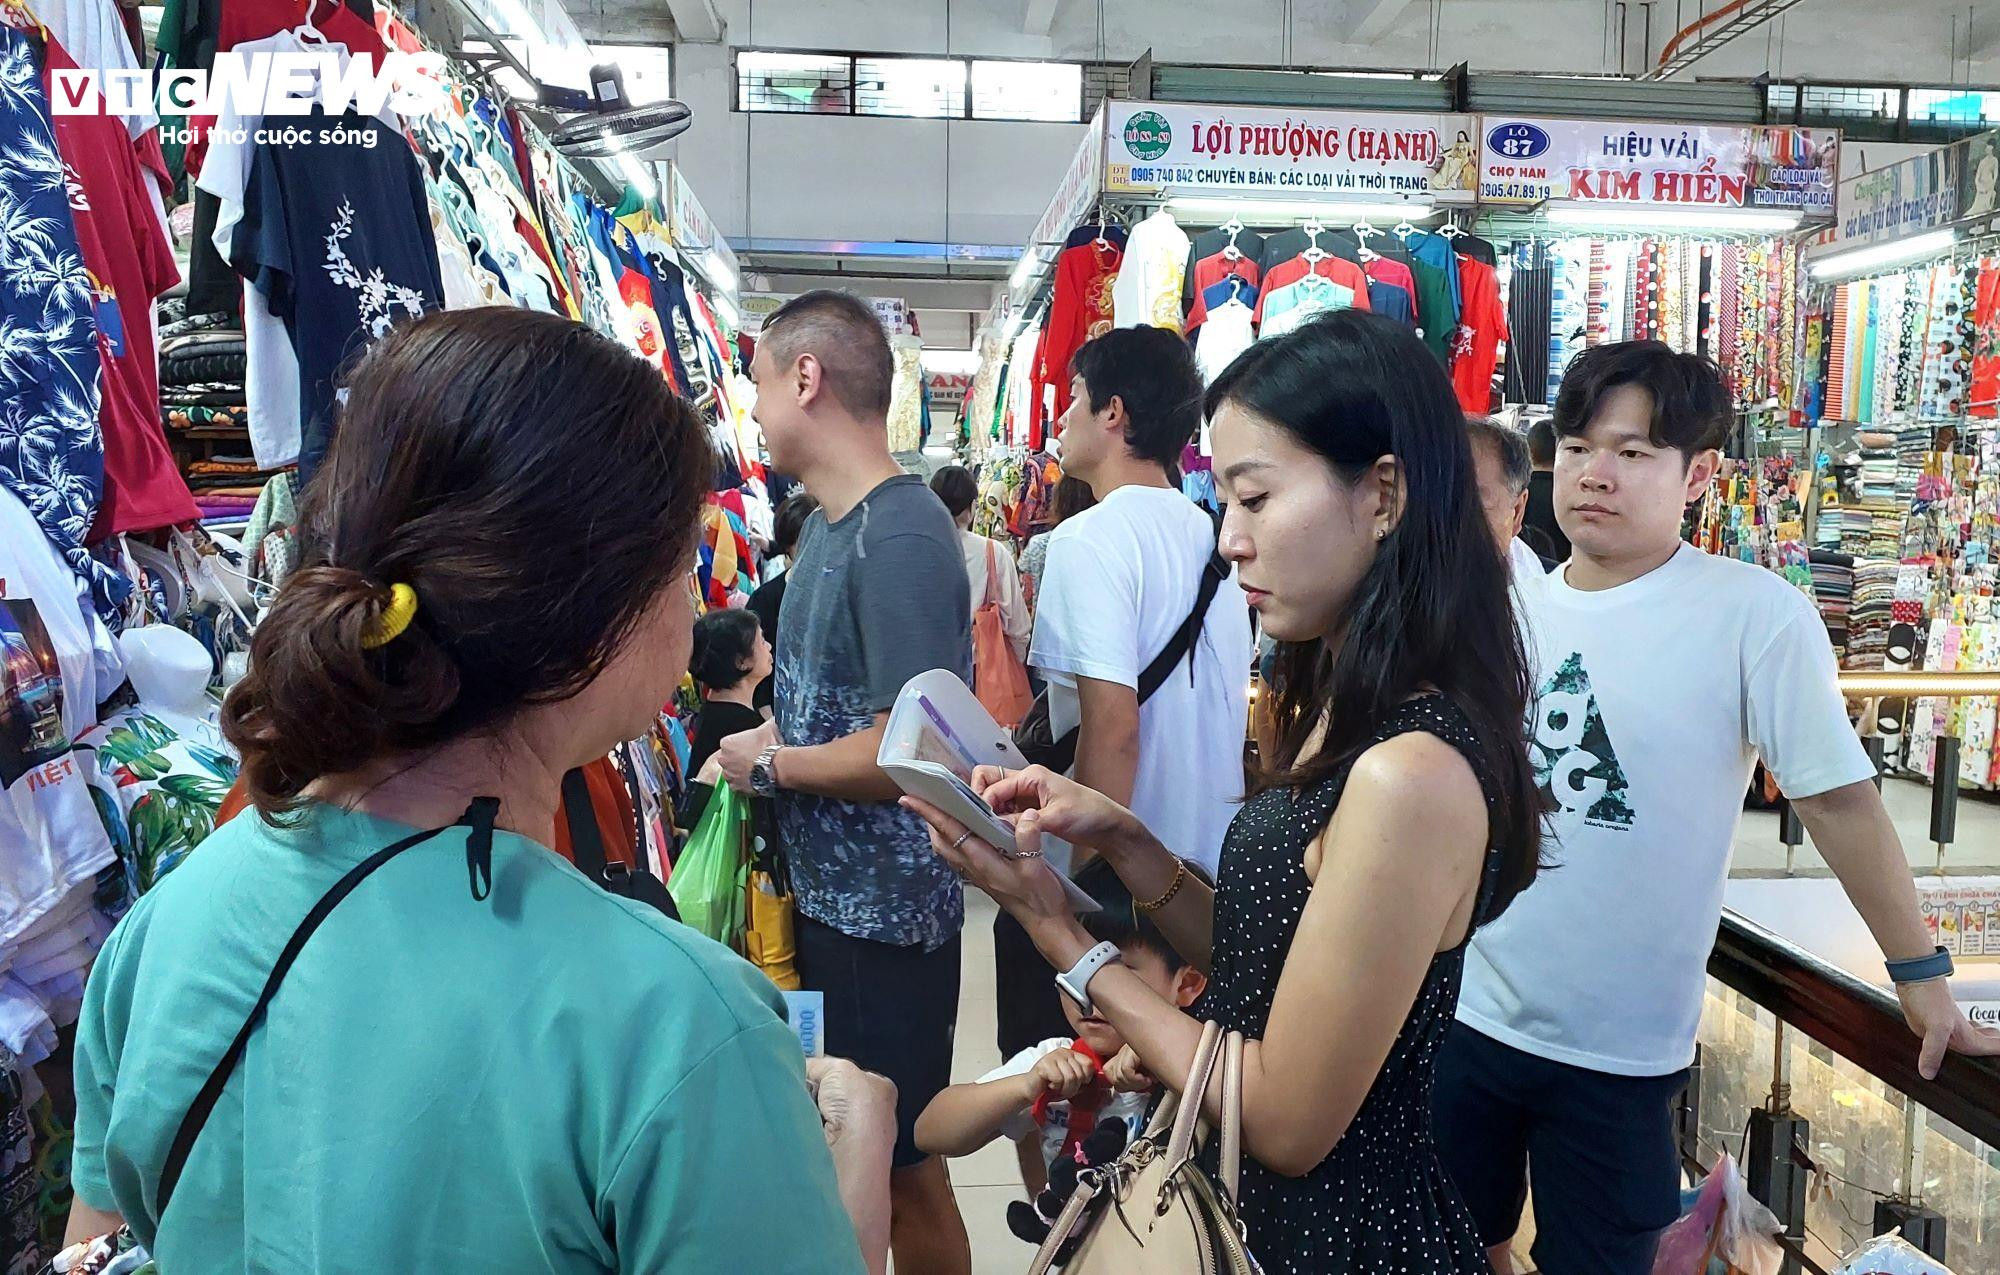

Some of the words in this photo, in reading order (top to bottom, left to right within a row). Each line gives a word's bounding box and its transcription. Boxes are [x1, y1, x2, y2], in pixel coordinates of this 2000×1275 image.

[1508, 126, 1529, 137] LÔ
[1192, 119, 1232, 160] LỢI
[1239, 120, 1340, 162] PHƯỢNG
[1348, 128, 1437, 166] (HẠNH)
[1503, 139, 1534, 156] 87
[1603, 131, 1652, 163] HIỆU
[1661, 131, 1698, 160] VẢI
[1131, 168, 1153, 182] 0905
[1157, 168, 1174, 182] 740
[1176, 169, 1193, 183] 842
[1197, 167, 1244, 184] CHUYÊN
[1249, 167, 1276, 185] BÁN:
[1280, 168, 1303, 185] CÁC
[1307, 173, 1332, 190] LOẠI
[1337, 169, 1355, 188] VẢI
[1359, 172, 1385, 189] THỜI
[1390, 176, 1428, 190] TRANG
[1568, 168, 1642, 200] KIM
[1652, 156, 1747, 204] HIỂN
[1771, 166, 1787, 182] CÁC
[1789, 170, 1807, 186] LOẠI
[1754, 186, 1773, 203] THỜI
[1775, 191, 1800, 204] TRANG
[1803, 192, 1819, 205] CAO
[27, 758, 73, 792] VIỆT
